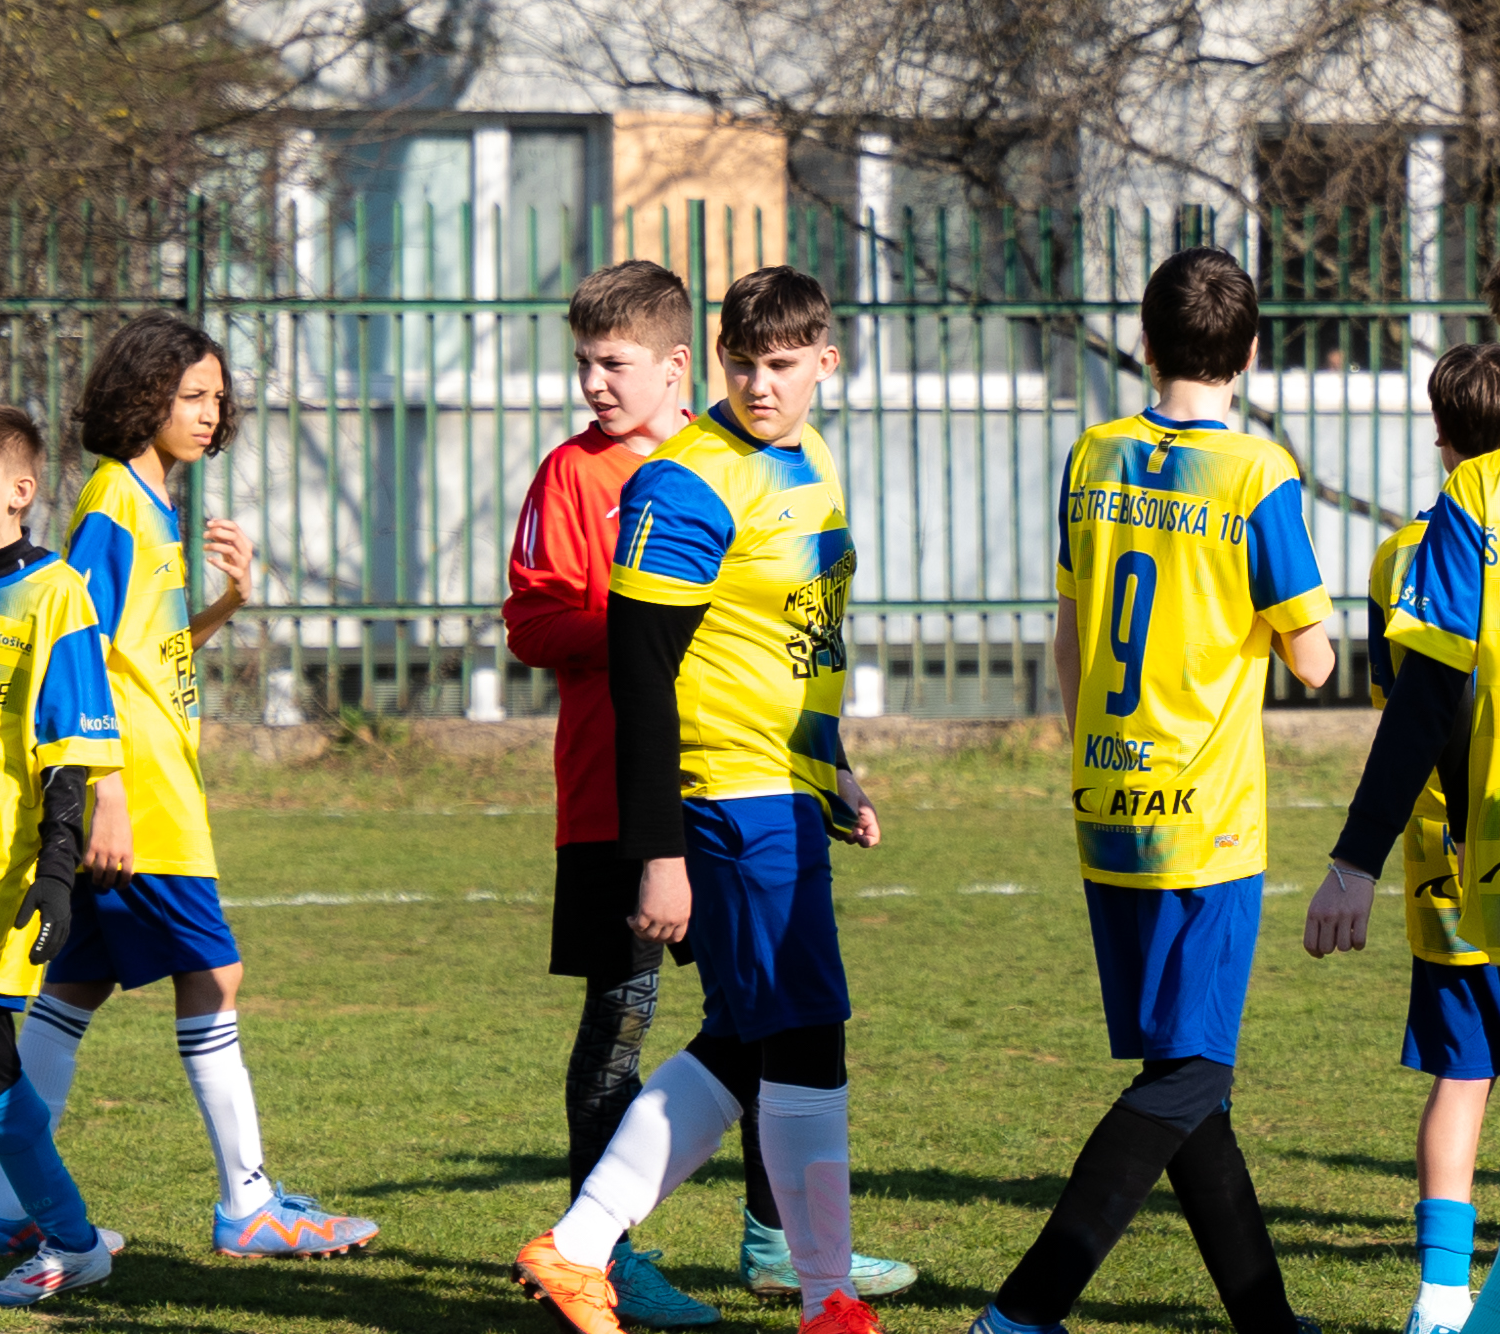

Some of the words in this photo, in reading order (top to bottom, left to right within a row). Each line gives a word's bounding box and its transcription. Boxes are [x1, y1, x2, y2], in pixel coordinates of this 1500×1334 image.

[1069, 485, 1086, 524] ZŠ
[1088, 490, 1210, 538] TREBIŠOVSKÁ
[1220, 511, 1245, 546] 10
[1105, 550, 1157, 718] 9
[1084, 732, 1155, 772] KOŠICE
[1109, 788, 1198, 816] ATAK
[36, 922, 52, 952] KIPSTA
